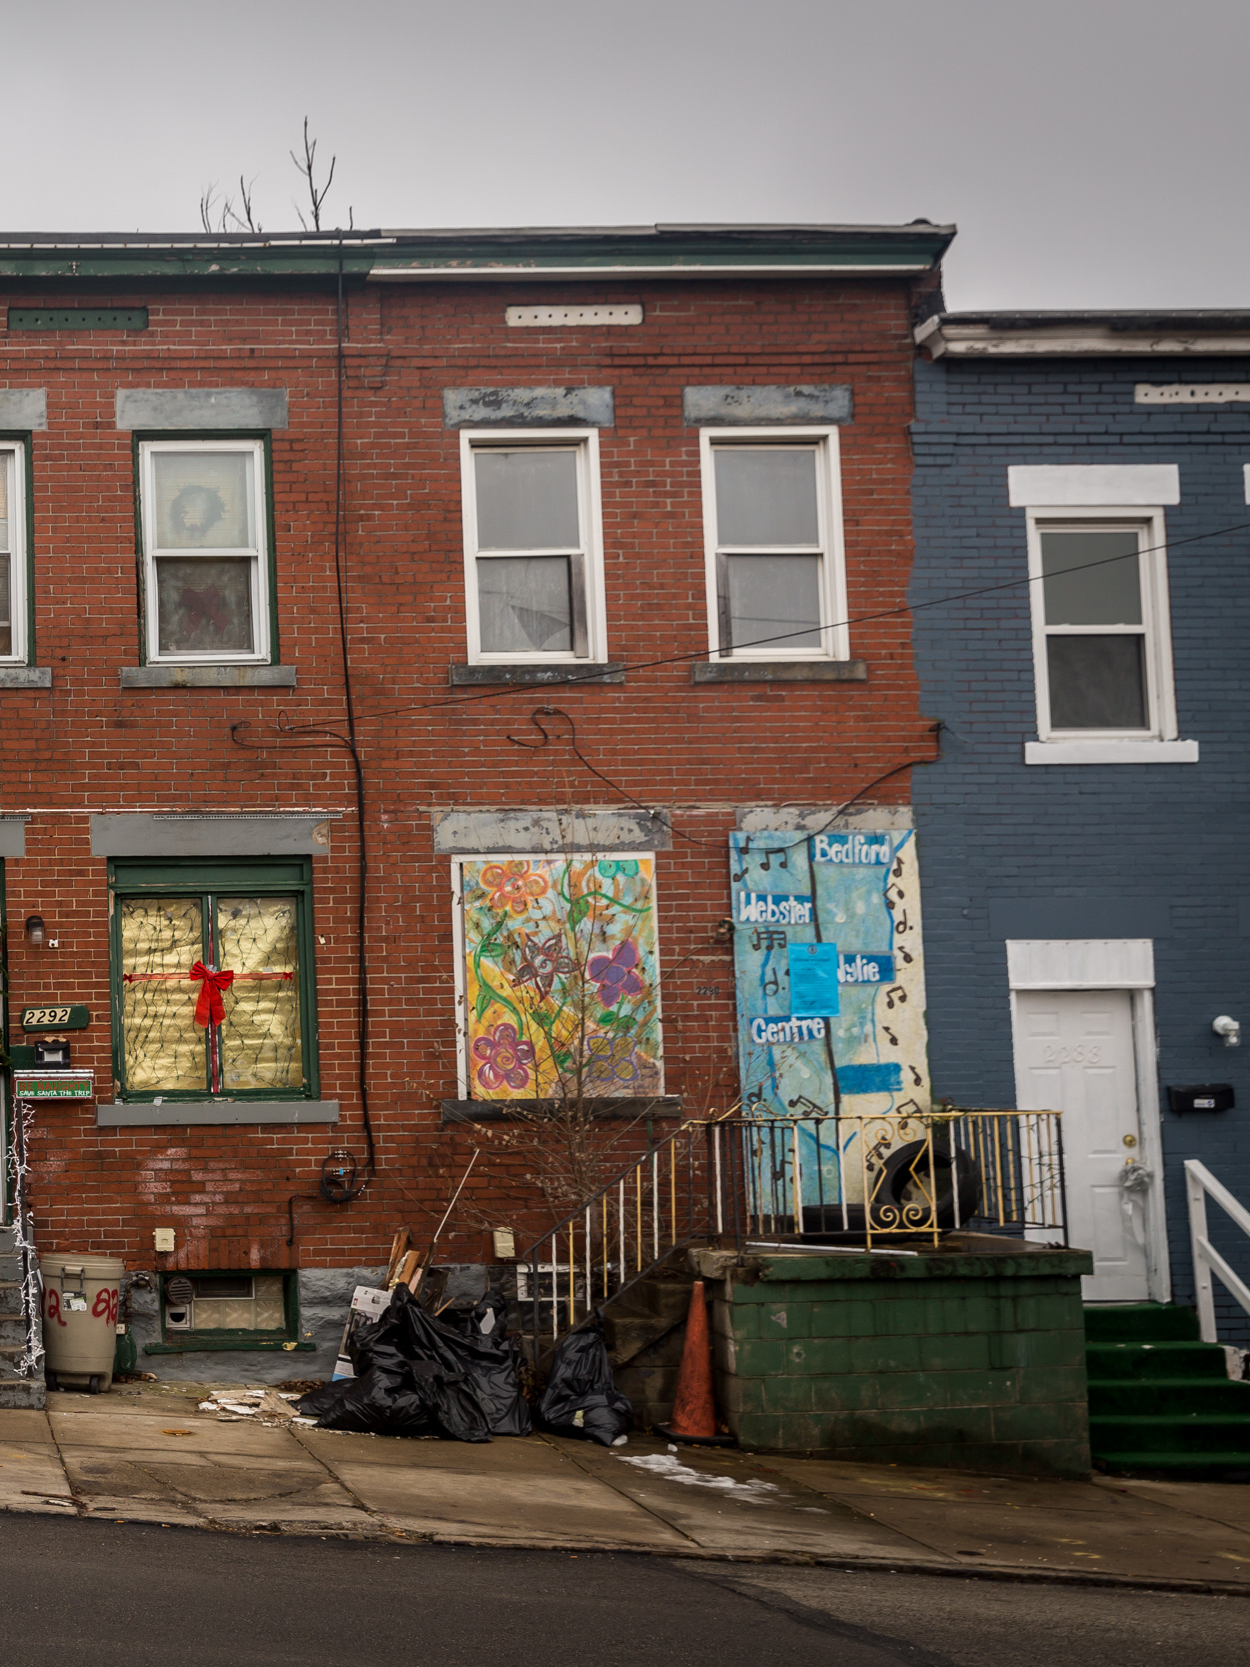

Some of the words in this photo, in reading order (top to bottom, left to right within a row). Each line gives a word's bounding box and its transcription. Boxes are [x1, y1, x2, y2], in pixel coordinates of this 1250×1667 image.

[814, 834, 891, 864] Bedford
[739, 891, 813, 924] Webster
[25, 1009, 68, 1025] 2292
[752, 1016, 826, 1044] Centre
[1043, 1044, 1102, 1065] 2288
[19, 1082, 34, 1091] BE
[37, 1081, 89, 1091] NAUGHTY
